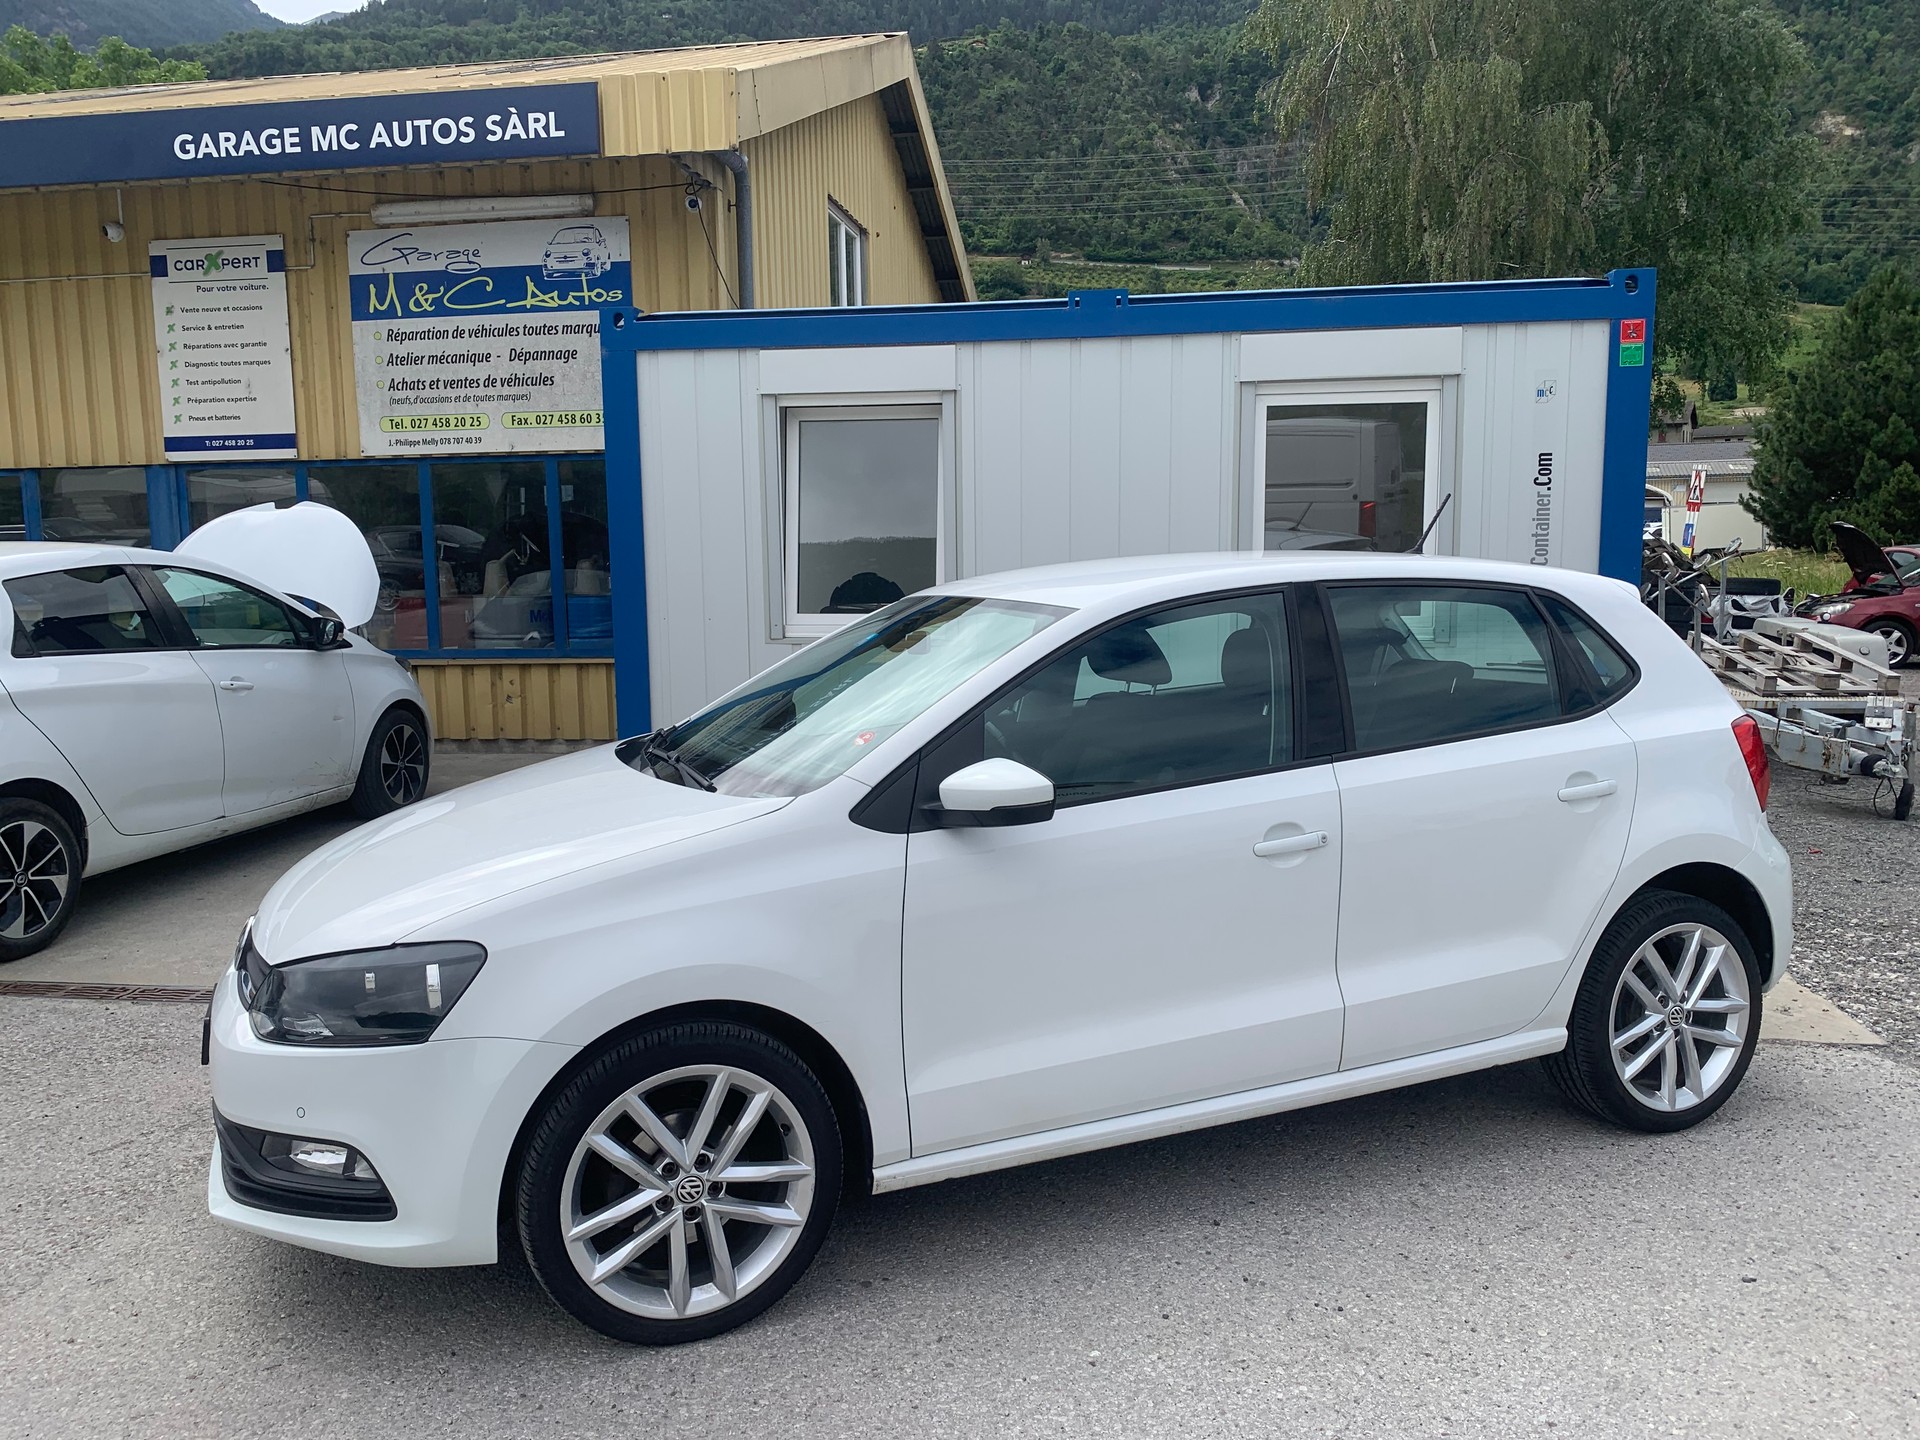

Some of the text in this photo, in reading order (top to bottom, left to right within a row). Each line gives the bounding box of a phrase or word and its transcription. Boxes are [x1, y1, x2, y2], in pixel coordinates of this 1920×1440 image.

[173, 107, 565, 161] GARAGE MC AUTOS SÀRL
[360, 233, 481, 273] Garage
[196, 285, 214, 293] Pour
[239, 283, 269, 291] voiture.
[369, 272, 623, 317] M & C Autos
[214, 323, 244, 331] entretien
[386, 322, 600, 345] Réparation de véhicules toutes marqu
[183, 342, 222, 351] Réparations
[240, 341, 267, 349] garantie
[386, 351, 426, 367] Atelier
[427, 349, 491, 367] mécanique
[508, 347, 578, 365] Dépannage
[184, 361, 218, 369] Diagnostic
[243, 359, 271, 367] marques
[201, 378, 241, 386] antipollution
[388, 372, 555, 392] Achats et ventes de véhicules
[187, 395, 257, 404] Préparation expertise
[454, 395, 461, 403] et
[462, 393, 472, 403] de
[473, 393, 495, 402] toutes
[496, 391, 532, 403] marques)
[389, 416, 482, 430] Tel. 027 458 20 25
[511, 412, 604, 426] Fax. 027 458 60 3
[388, 438, 420, 448] J.-Philippe
[421, 438, 438, 447] Melly
[439, 437, 452, 445] 078
[452, 437, 463, 445] 707
[474, 436, 482, 444] 39
